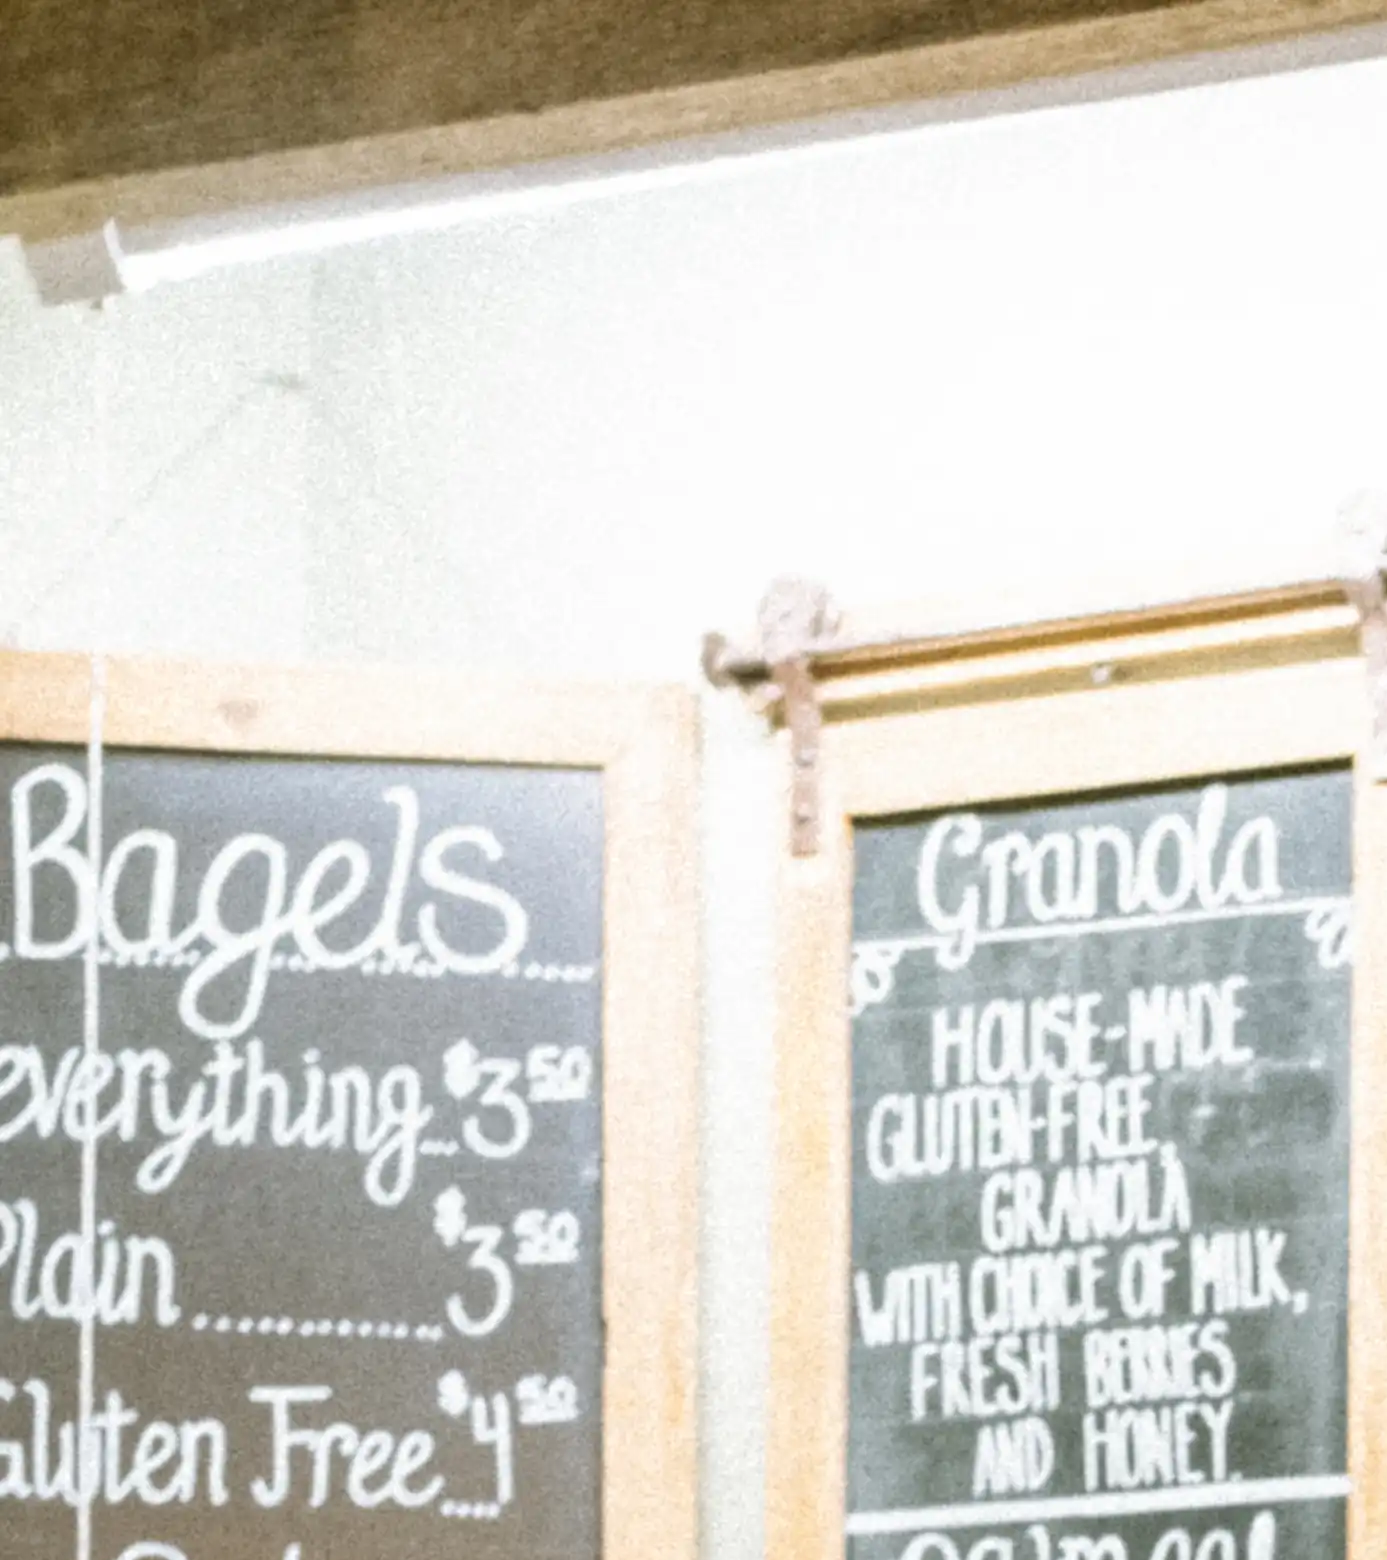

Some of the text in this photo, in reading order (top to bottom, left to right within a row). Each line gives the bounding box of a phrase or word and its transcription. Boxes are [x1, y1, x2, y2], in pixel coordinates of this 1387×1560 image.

[12, 763, 529, 1038] Bagels
[917, 783, 1285, 970] Granola
[932, 976, 1254, 1089] HOUSE-MADE
[0, 1198, 181, 1327] lain
[978, 1159, 1191, 1254] GRANOLA
[854, 1263, 961, 1347] WITH
[968, 1248, 1107, 1340] CHOICE
[1119, 1239, 1178, 1319] OF
[910, 1321, 1237, 1422] FRESH BERRIES
[248, 1384, 442, 1510] Free
[973, 1423, 1054, 1497] AND
